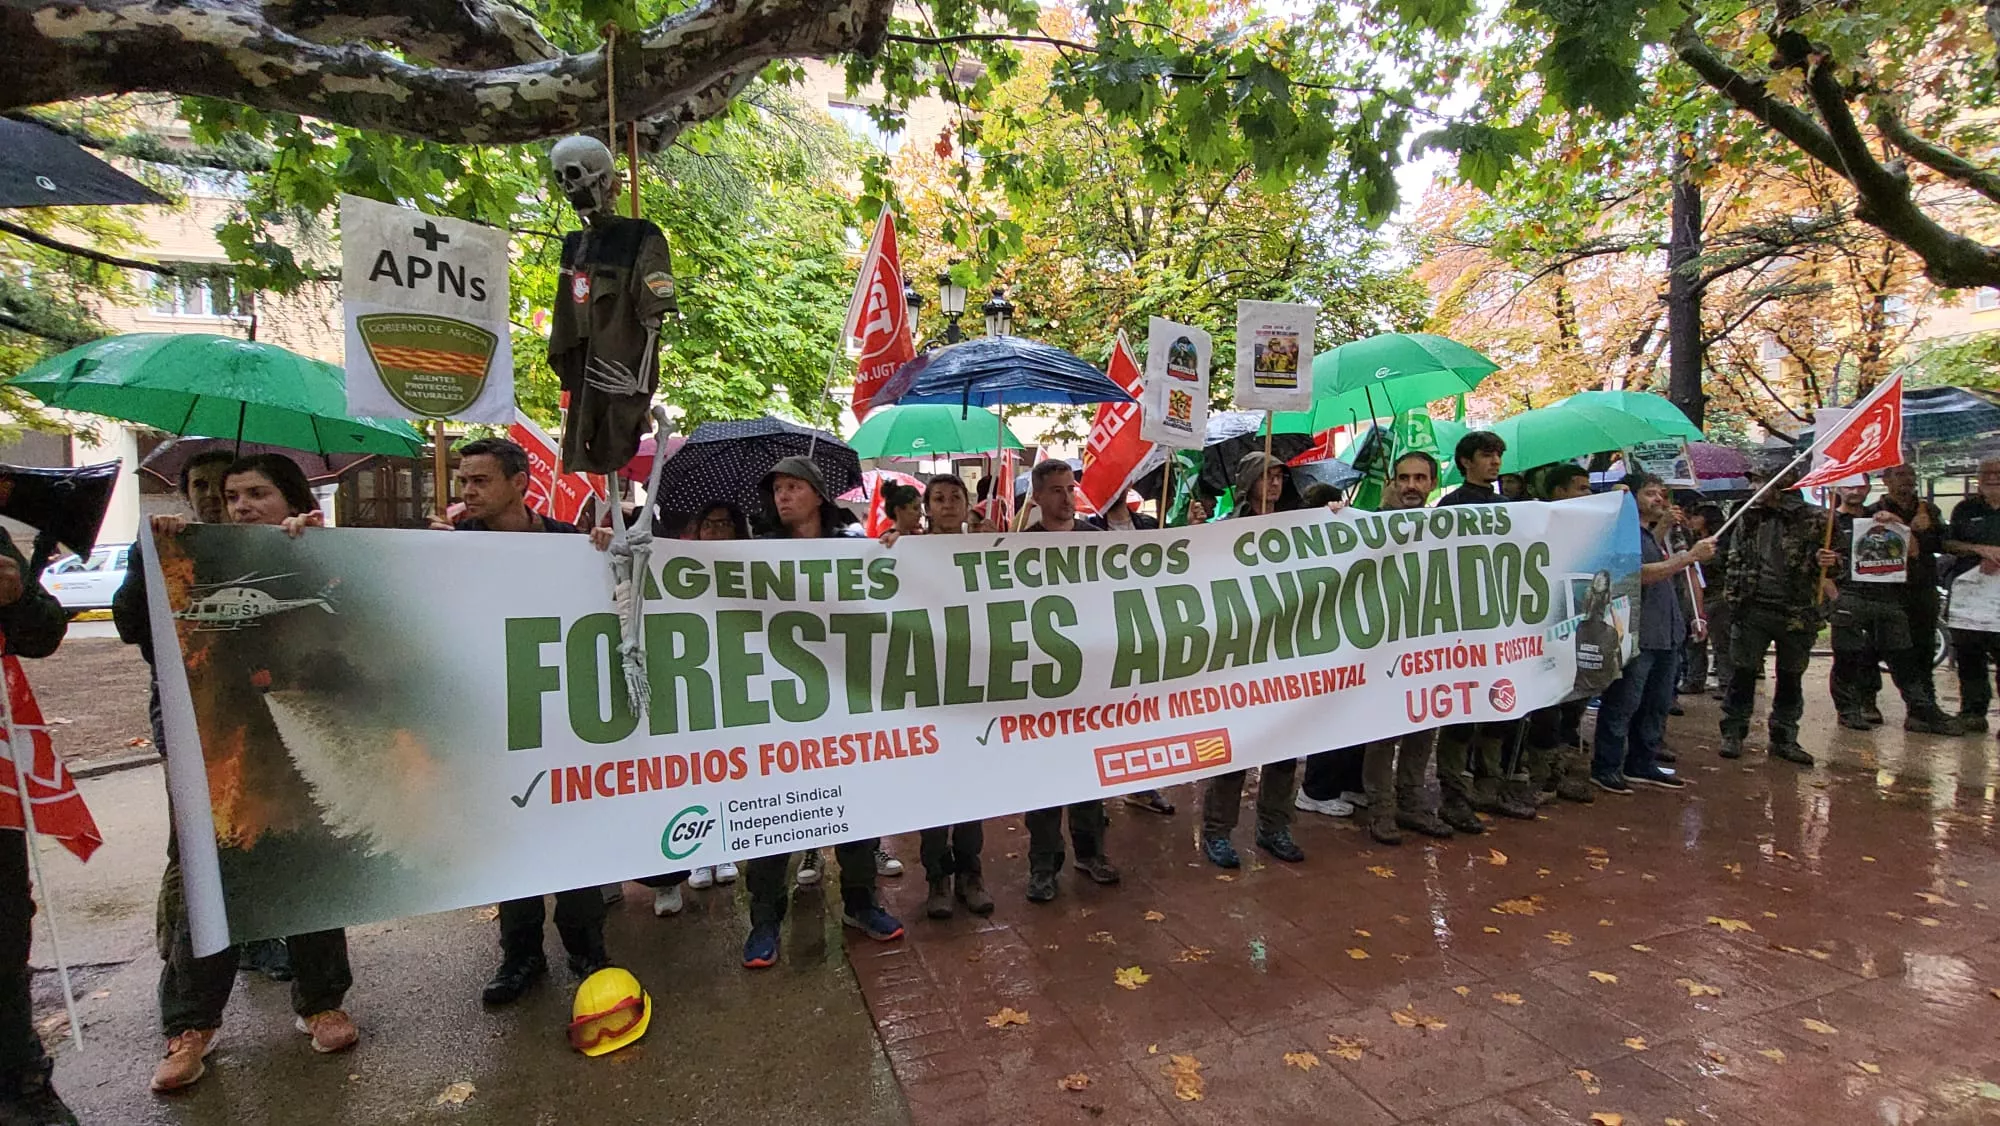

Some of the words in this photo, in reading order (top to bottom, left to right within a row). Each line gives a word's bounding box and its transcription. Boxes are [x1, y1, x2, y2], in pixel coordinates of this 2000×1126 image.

[368, 249, 487, 301] APNs
[369, 323, 426, 334] GOBIERNO
[428, 325, 443, 334] DE
[404, 390, 465, 401] NATURALEZA
[412, 374, 456, 384] AGENTES
[953, 537, 1191, 592] TÉCNICOS
[1233, 506, 1512, 567] CONDUCTORES
[504, 595, 1083, 751] FORESTALES
[1110, 542, 1550, 689] ABANDONADOS
[1401, 639, 1487, 677] GESTIÓN
[1000, 692, 1160, 744] PROTECCIÓN
[1168, 663, 1367, 720] MEDIOAMBIENTAL
[1405, 681, 1480, 723] UGT
[550, 746, 749, 804] INCENDIOS
[759, 724, 940, 776] FORESTALES
[1101, 742, 1191, 778] CCOO
[728, 794, 781, 813] Central
[786, 785, 842, 805] Sindical
[671, 818, 716, 842] CSIF
[729, 806, 833, 832] Independiente
[837, 805, 845, 818] y
[731, 837, 750, 851] de
[754, 822, 849, 847] Funcionarios
